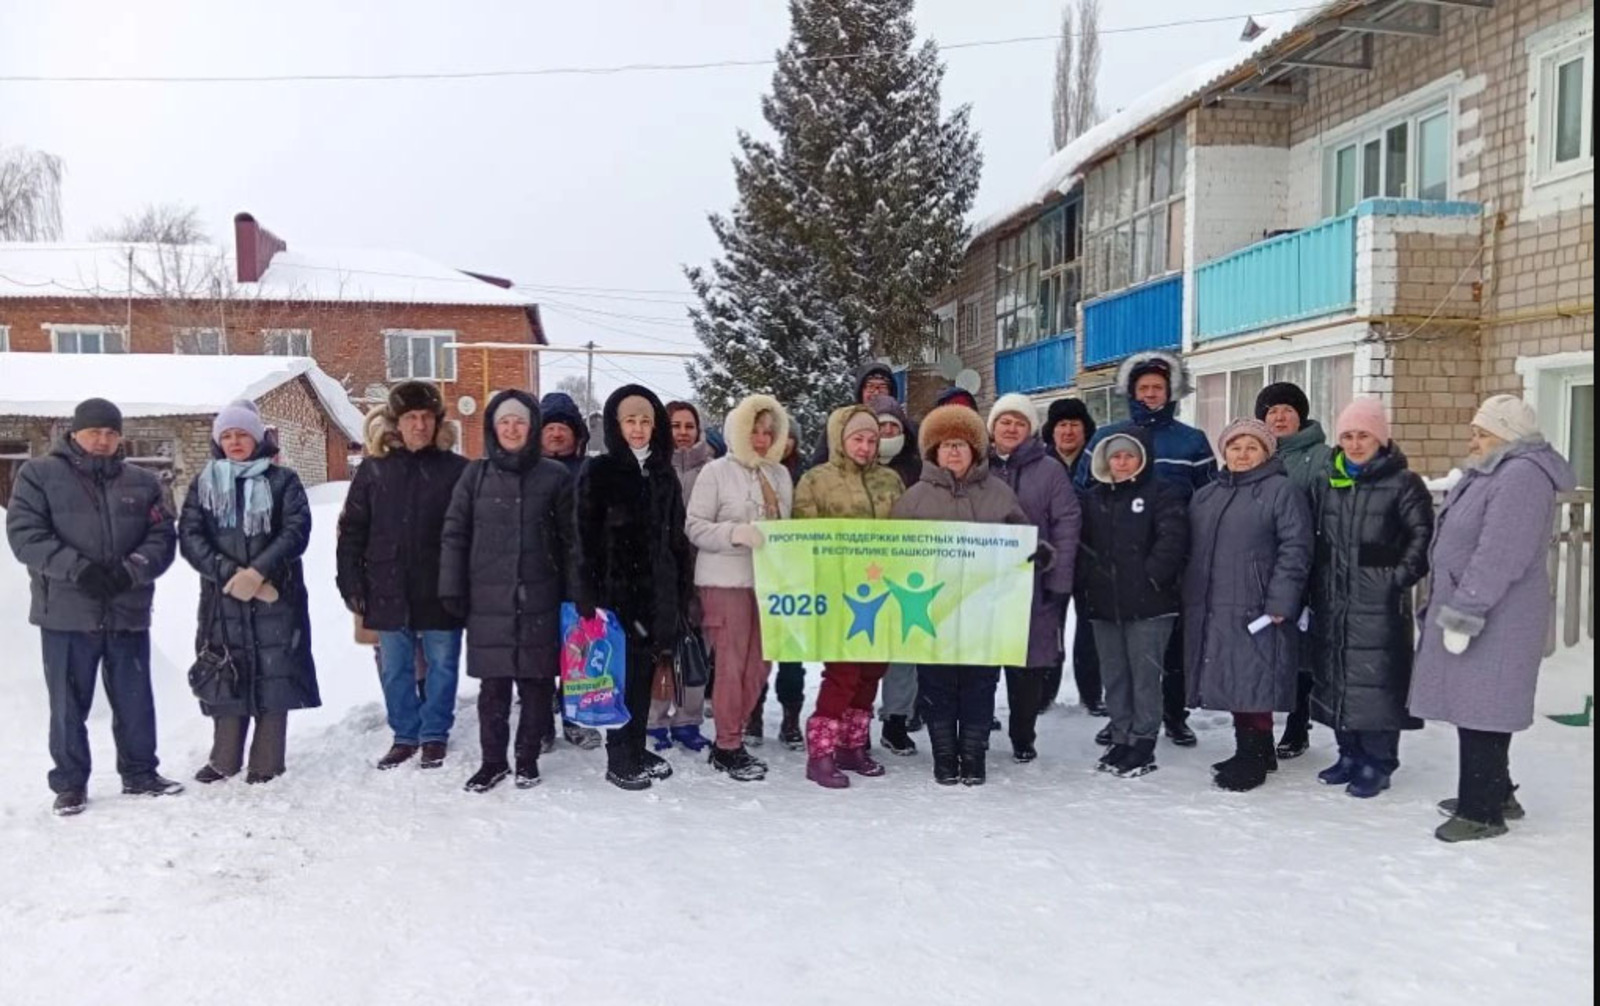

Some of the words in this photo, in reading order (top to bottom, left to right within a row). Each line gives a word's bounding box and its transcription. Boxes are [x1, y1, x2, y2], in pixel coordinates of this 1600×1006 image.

[1131, 497, 1145, 513] C
[768, 532, 832, 543] ПРОГРАММА
[835, 532, 899, 544] ПОДДЕРЖКИ
[902, 533, 954, 545] МЕСТНЫХ
[956, 535, 1019, 548] ИНИЦИАТИВ
[812, 546, 819, 555] В
[822, 546, 888, 556] РЕСПУБЛИКЕ
[891, 547, 975, 558] БАШКОРТОСТАН
[768, 594, 828, 616] 2026
